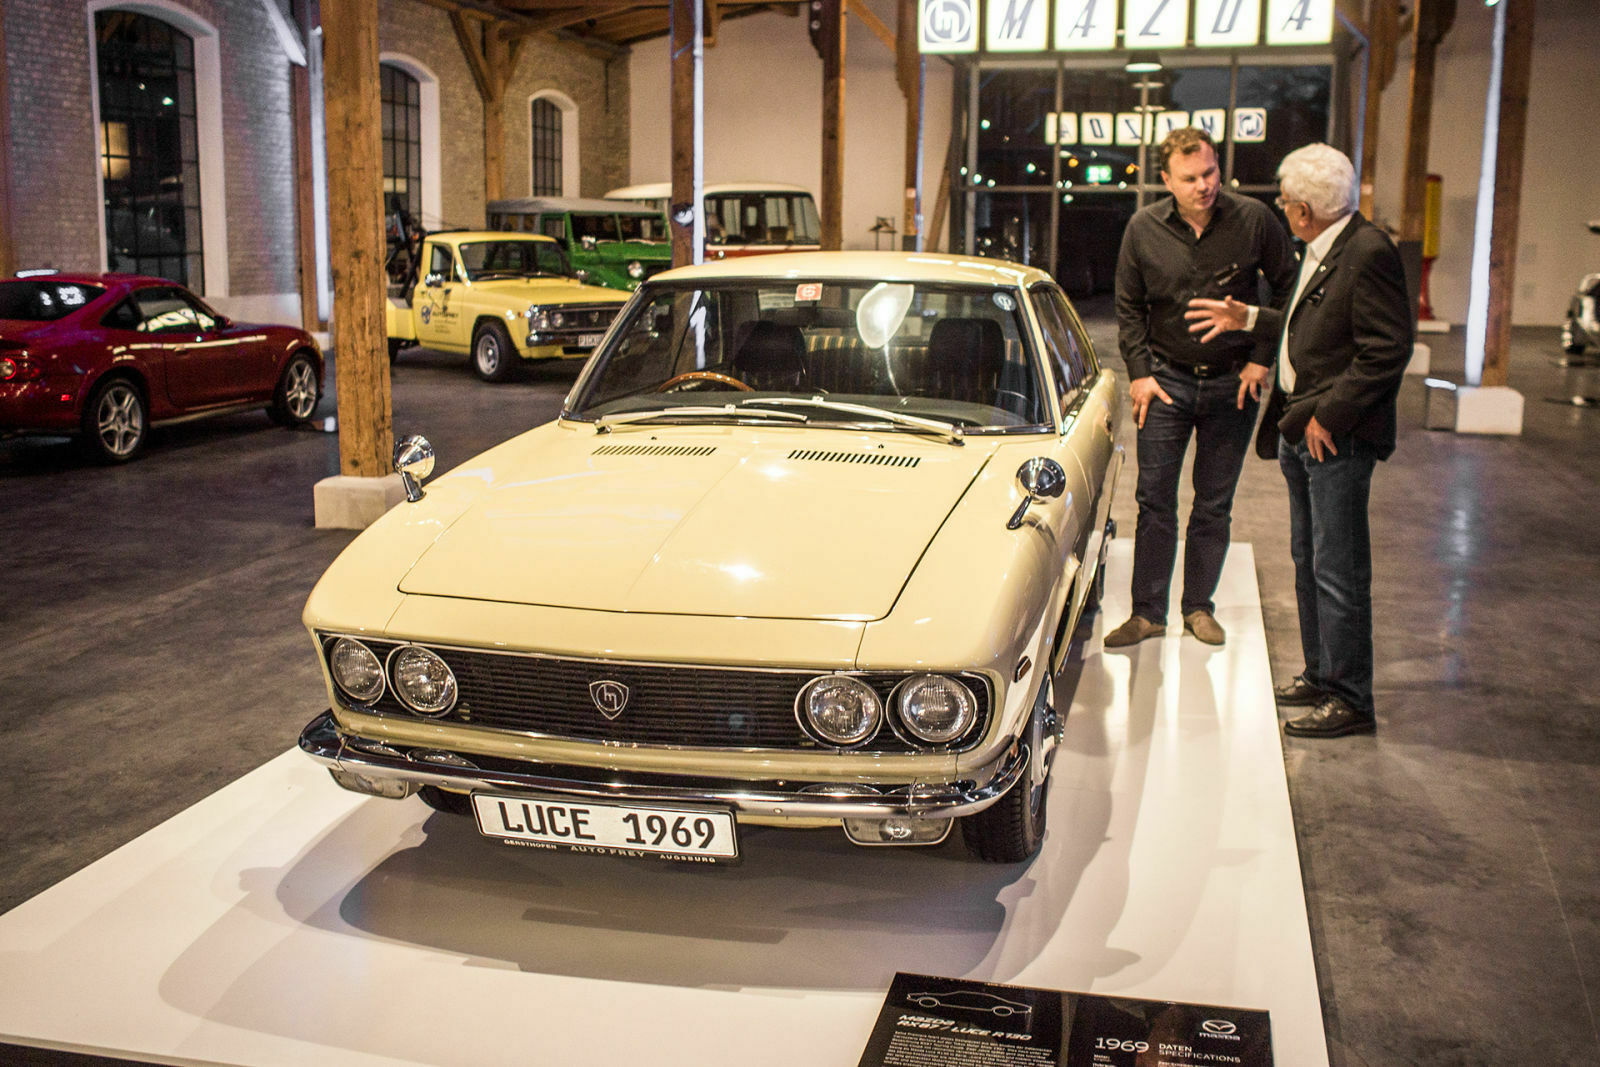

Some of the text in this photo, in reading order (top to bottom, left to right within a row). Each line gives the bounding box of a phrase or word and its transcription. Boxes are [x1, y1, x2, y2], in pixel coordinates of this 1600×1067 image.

[998, 0, 1314, 40] MAZDA
[498, 801, 715, 849] LUCE 1969
[504, 839, 716, 863] GERSTHOFEN AUTO FREY AUGSBURG
[951, 1026, 991, 1036] LUCE
[1094, 1036, 1150, 1054] 1969
[1158, 1042, 1193, 1053] DATEN
[1158, 1050, 1241, 1064] SPECIFICATIONS
